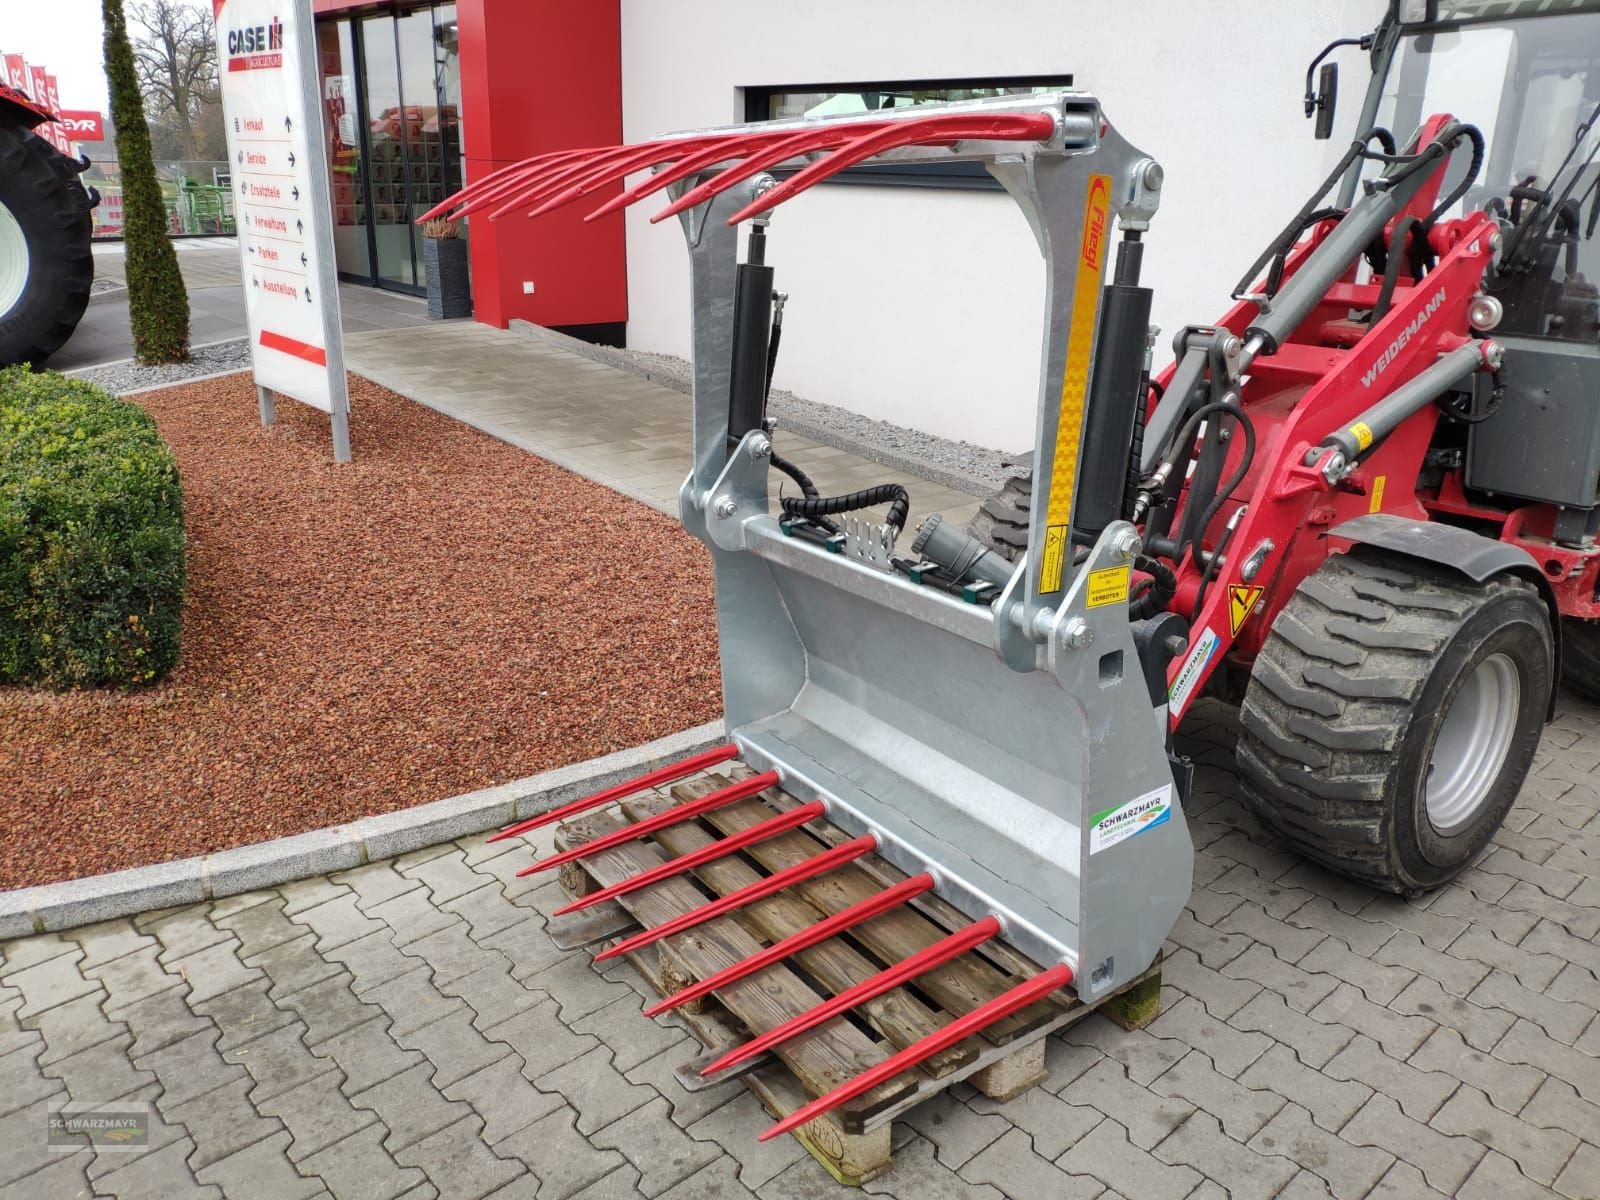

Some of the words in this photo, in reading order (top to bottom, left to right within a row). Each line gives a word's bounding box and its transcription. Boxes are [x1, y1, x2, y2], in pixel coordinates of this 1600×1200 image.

[228, 26, 265, 55] CASE
[246, 151, 267, 166] Service
[250, 183, 281, 199] Ersatzteile
[254, 215, 287, 233] Verwaltung
[1085, 206, 1105, 272] Fliegl
[258, 246, 279, 261] Parken
[262, 279, 298, 299] Ausstellung
[1361, 286, 1447, 388] WEIDEMANN
[1171, 640, 1208, 702] SCHWARZMAYR
[1098, 797, 1161, 831] SCHWARZMAYR
